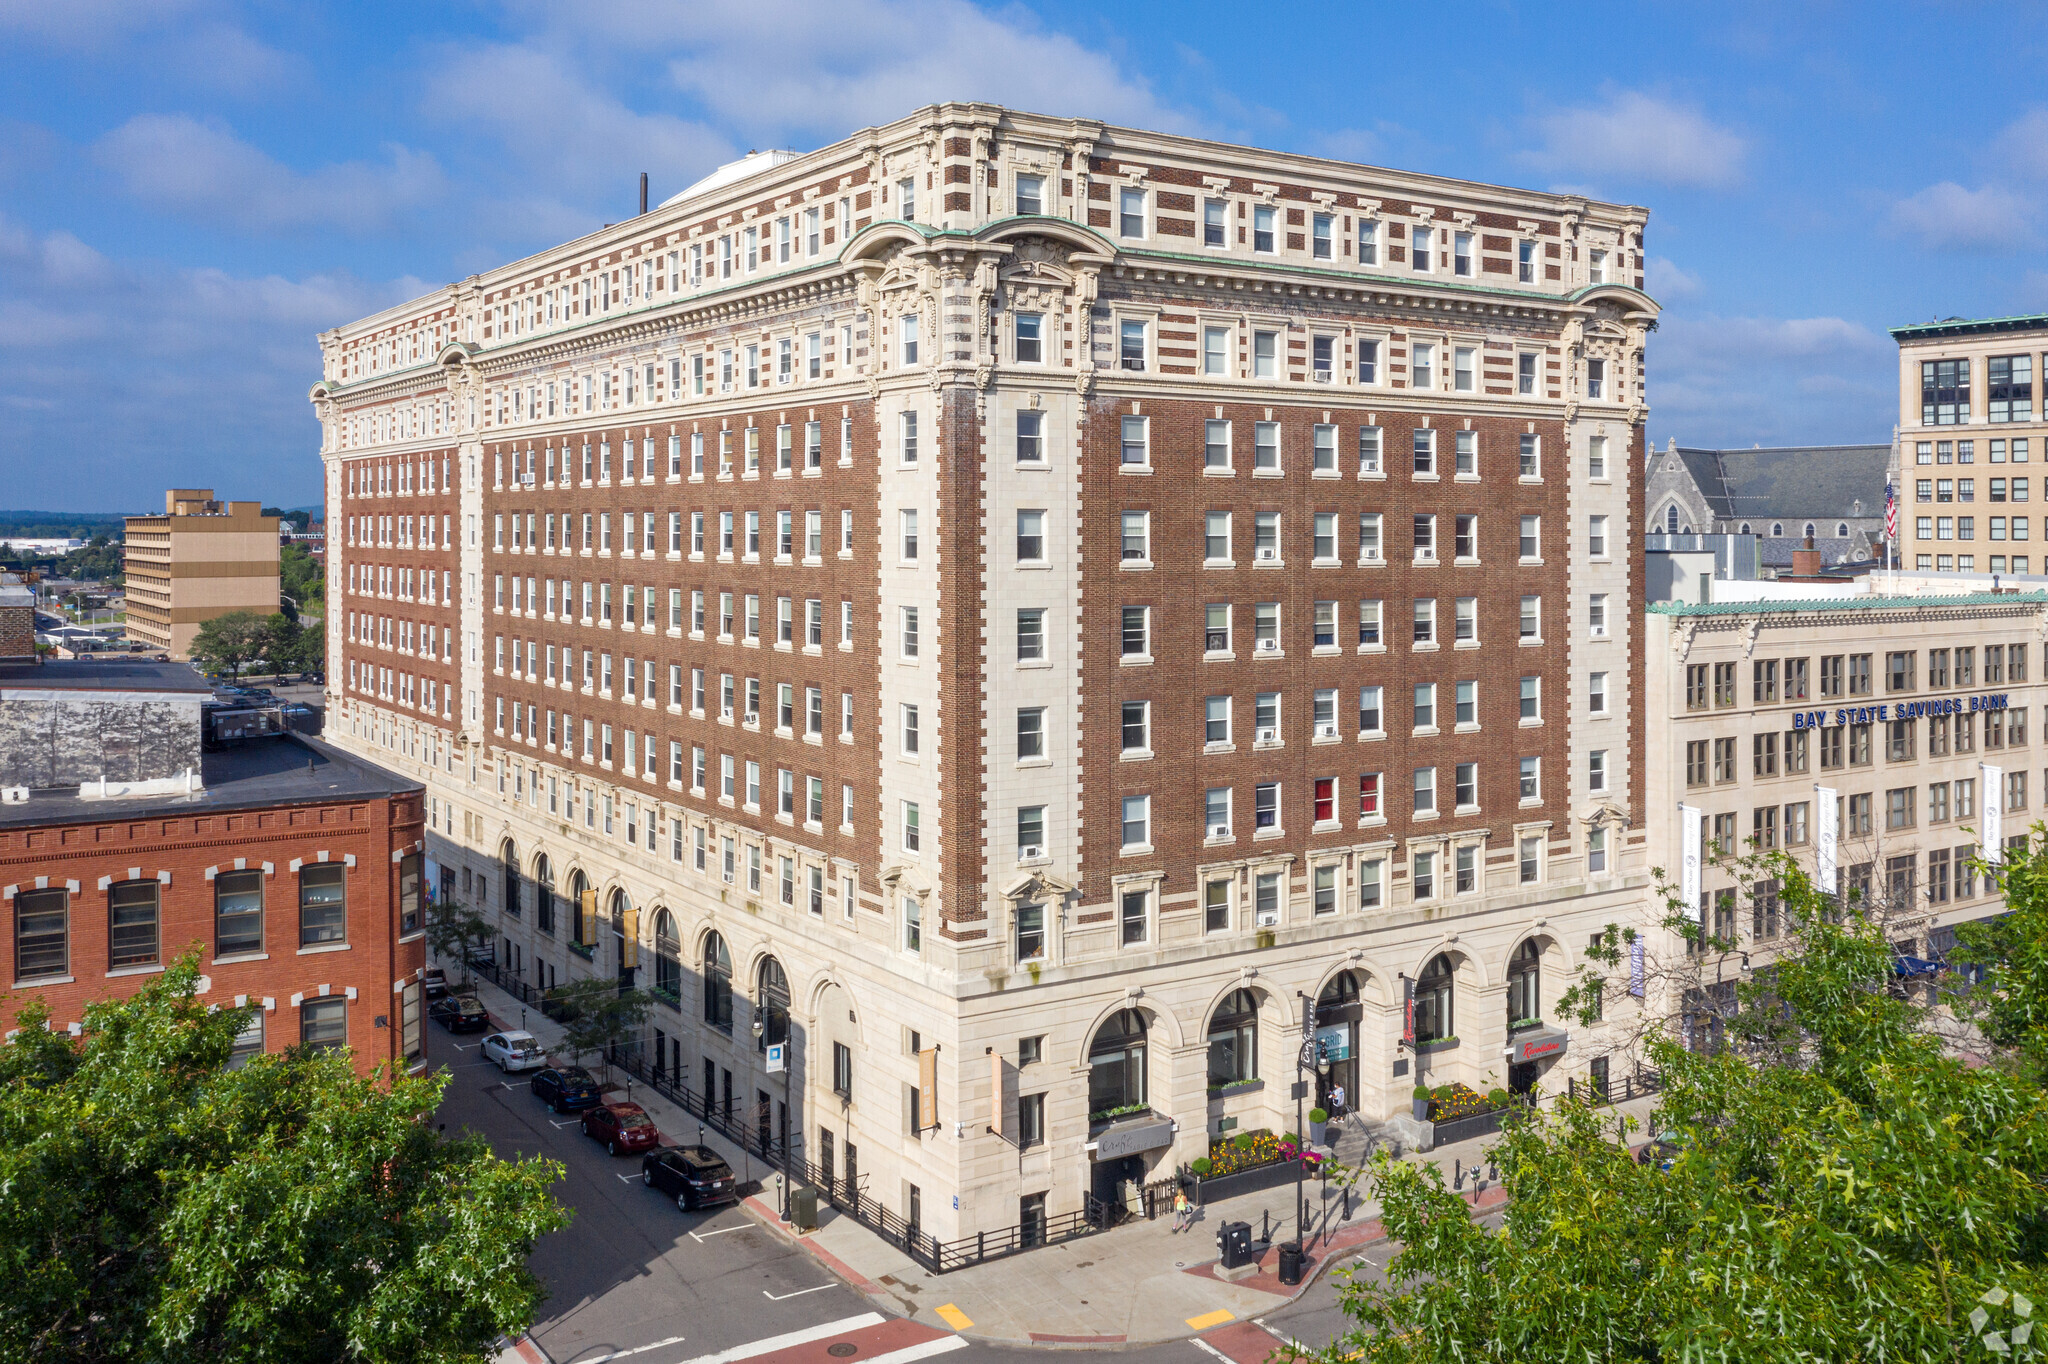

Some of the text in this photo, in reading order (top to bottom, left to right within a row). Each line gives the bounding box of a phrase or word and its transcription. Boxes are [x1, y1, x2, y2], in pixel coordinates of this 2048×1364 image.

[1794, 693, 2009, 728] BAY STATE SAVINGS BANK
[1302, 1032, 1313, 1063] Craft
[1326, 1034, 1342, 1048] GRID
[1522, 1042, 1560, 1059] Revolution
